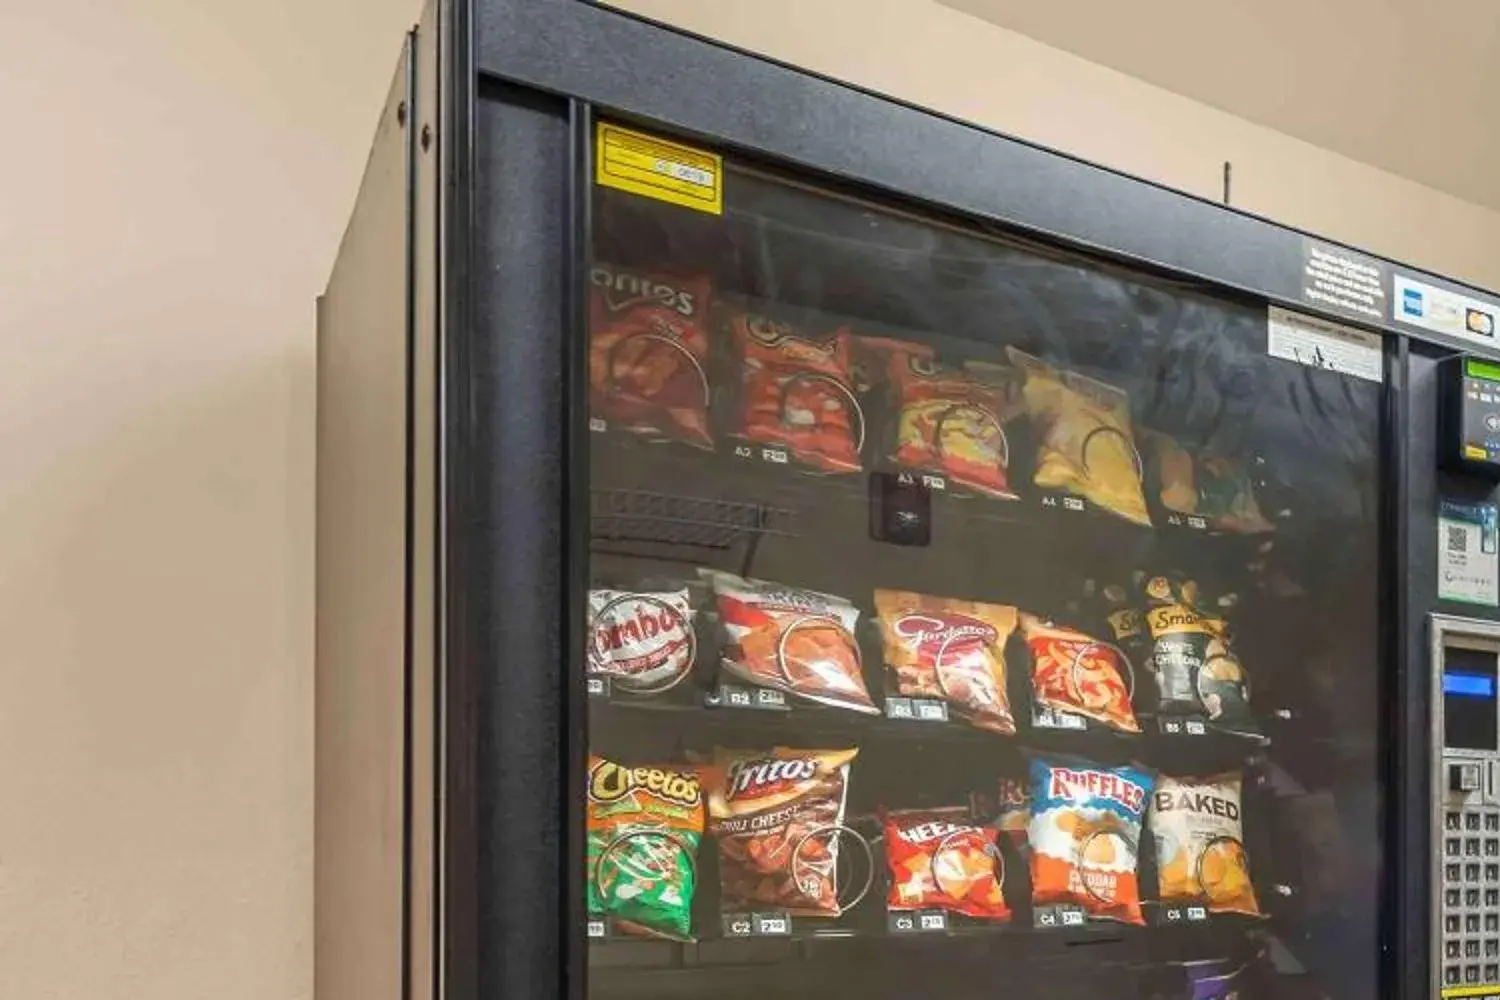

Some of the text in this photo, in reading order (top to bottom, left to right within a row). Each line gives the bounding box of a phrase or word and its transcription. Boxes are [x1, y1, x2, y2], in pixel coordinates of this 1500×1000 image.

[594, 759, 700, 801] Cheetos
[1155, 791, 1239, 822] BAKED
[732, 921, 750, 933] C2
